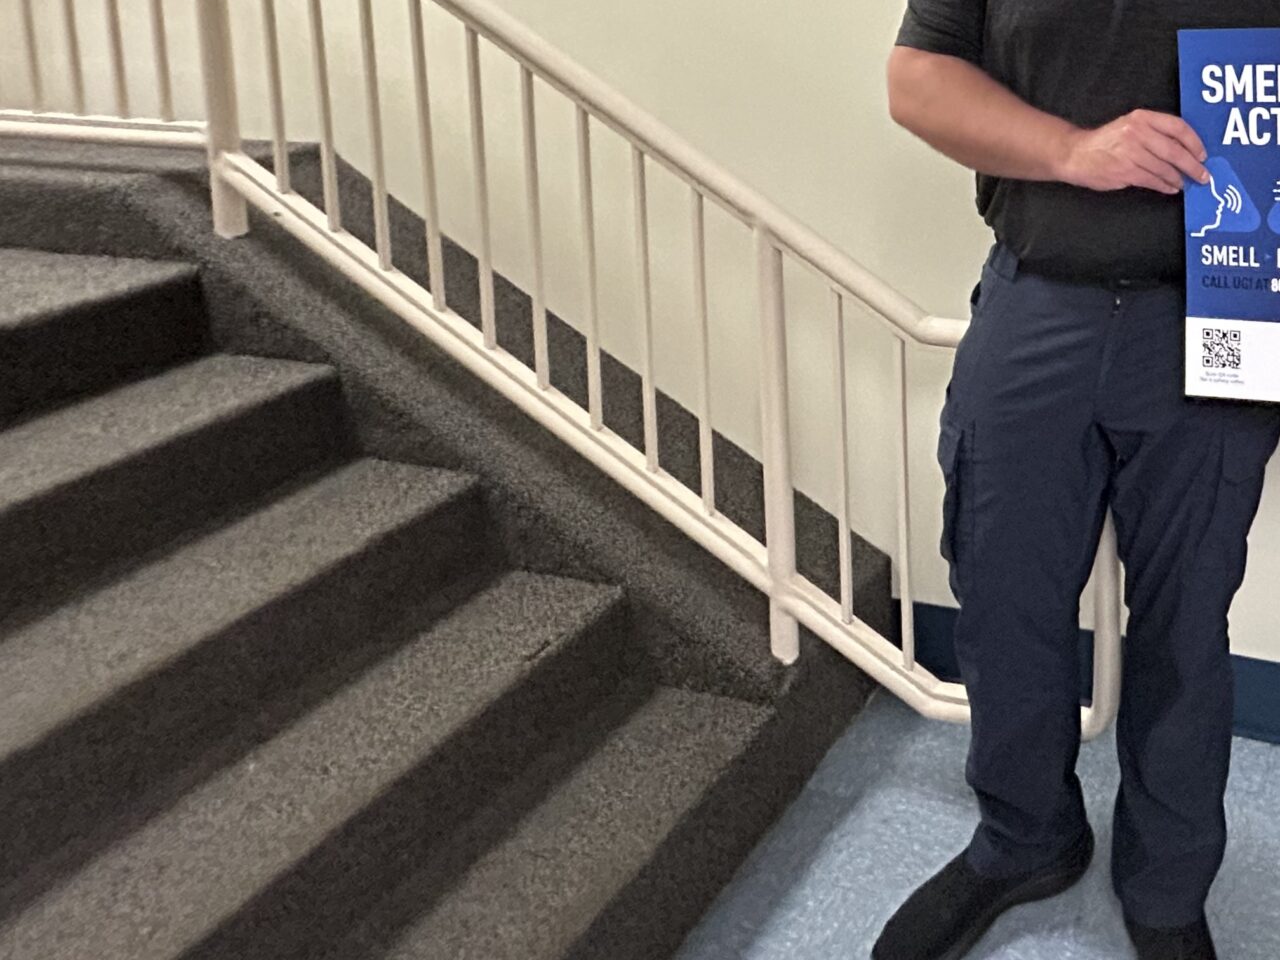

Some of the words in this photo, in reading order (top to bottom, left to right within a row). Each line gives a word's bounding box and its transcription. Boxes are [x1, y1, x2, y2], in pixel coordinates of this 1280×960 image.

[1201, 244, 1260, 268] SMELL
[1202, 274, 1230, 289] CALL
[1232, 276, 1253, 290] UGI
[1255, 278, 1269, 291] AT
